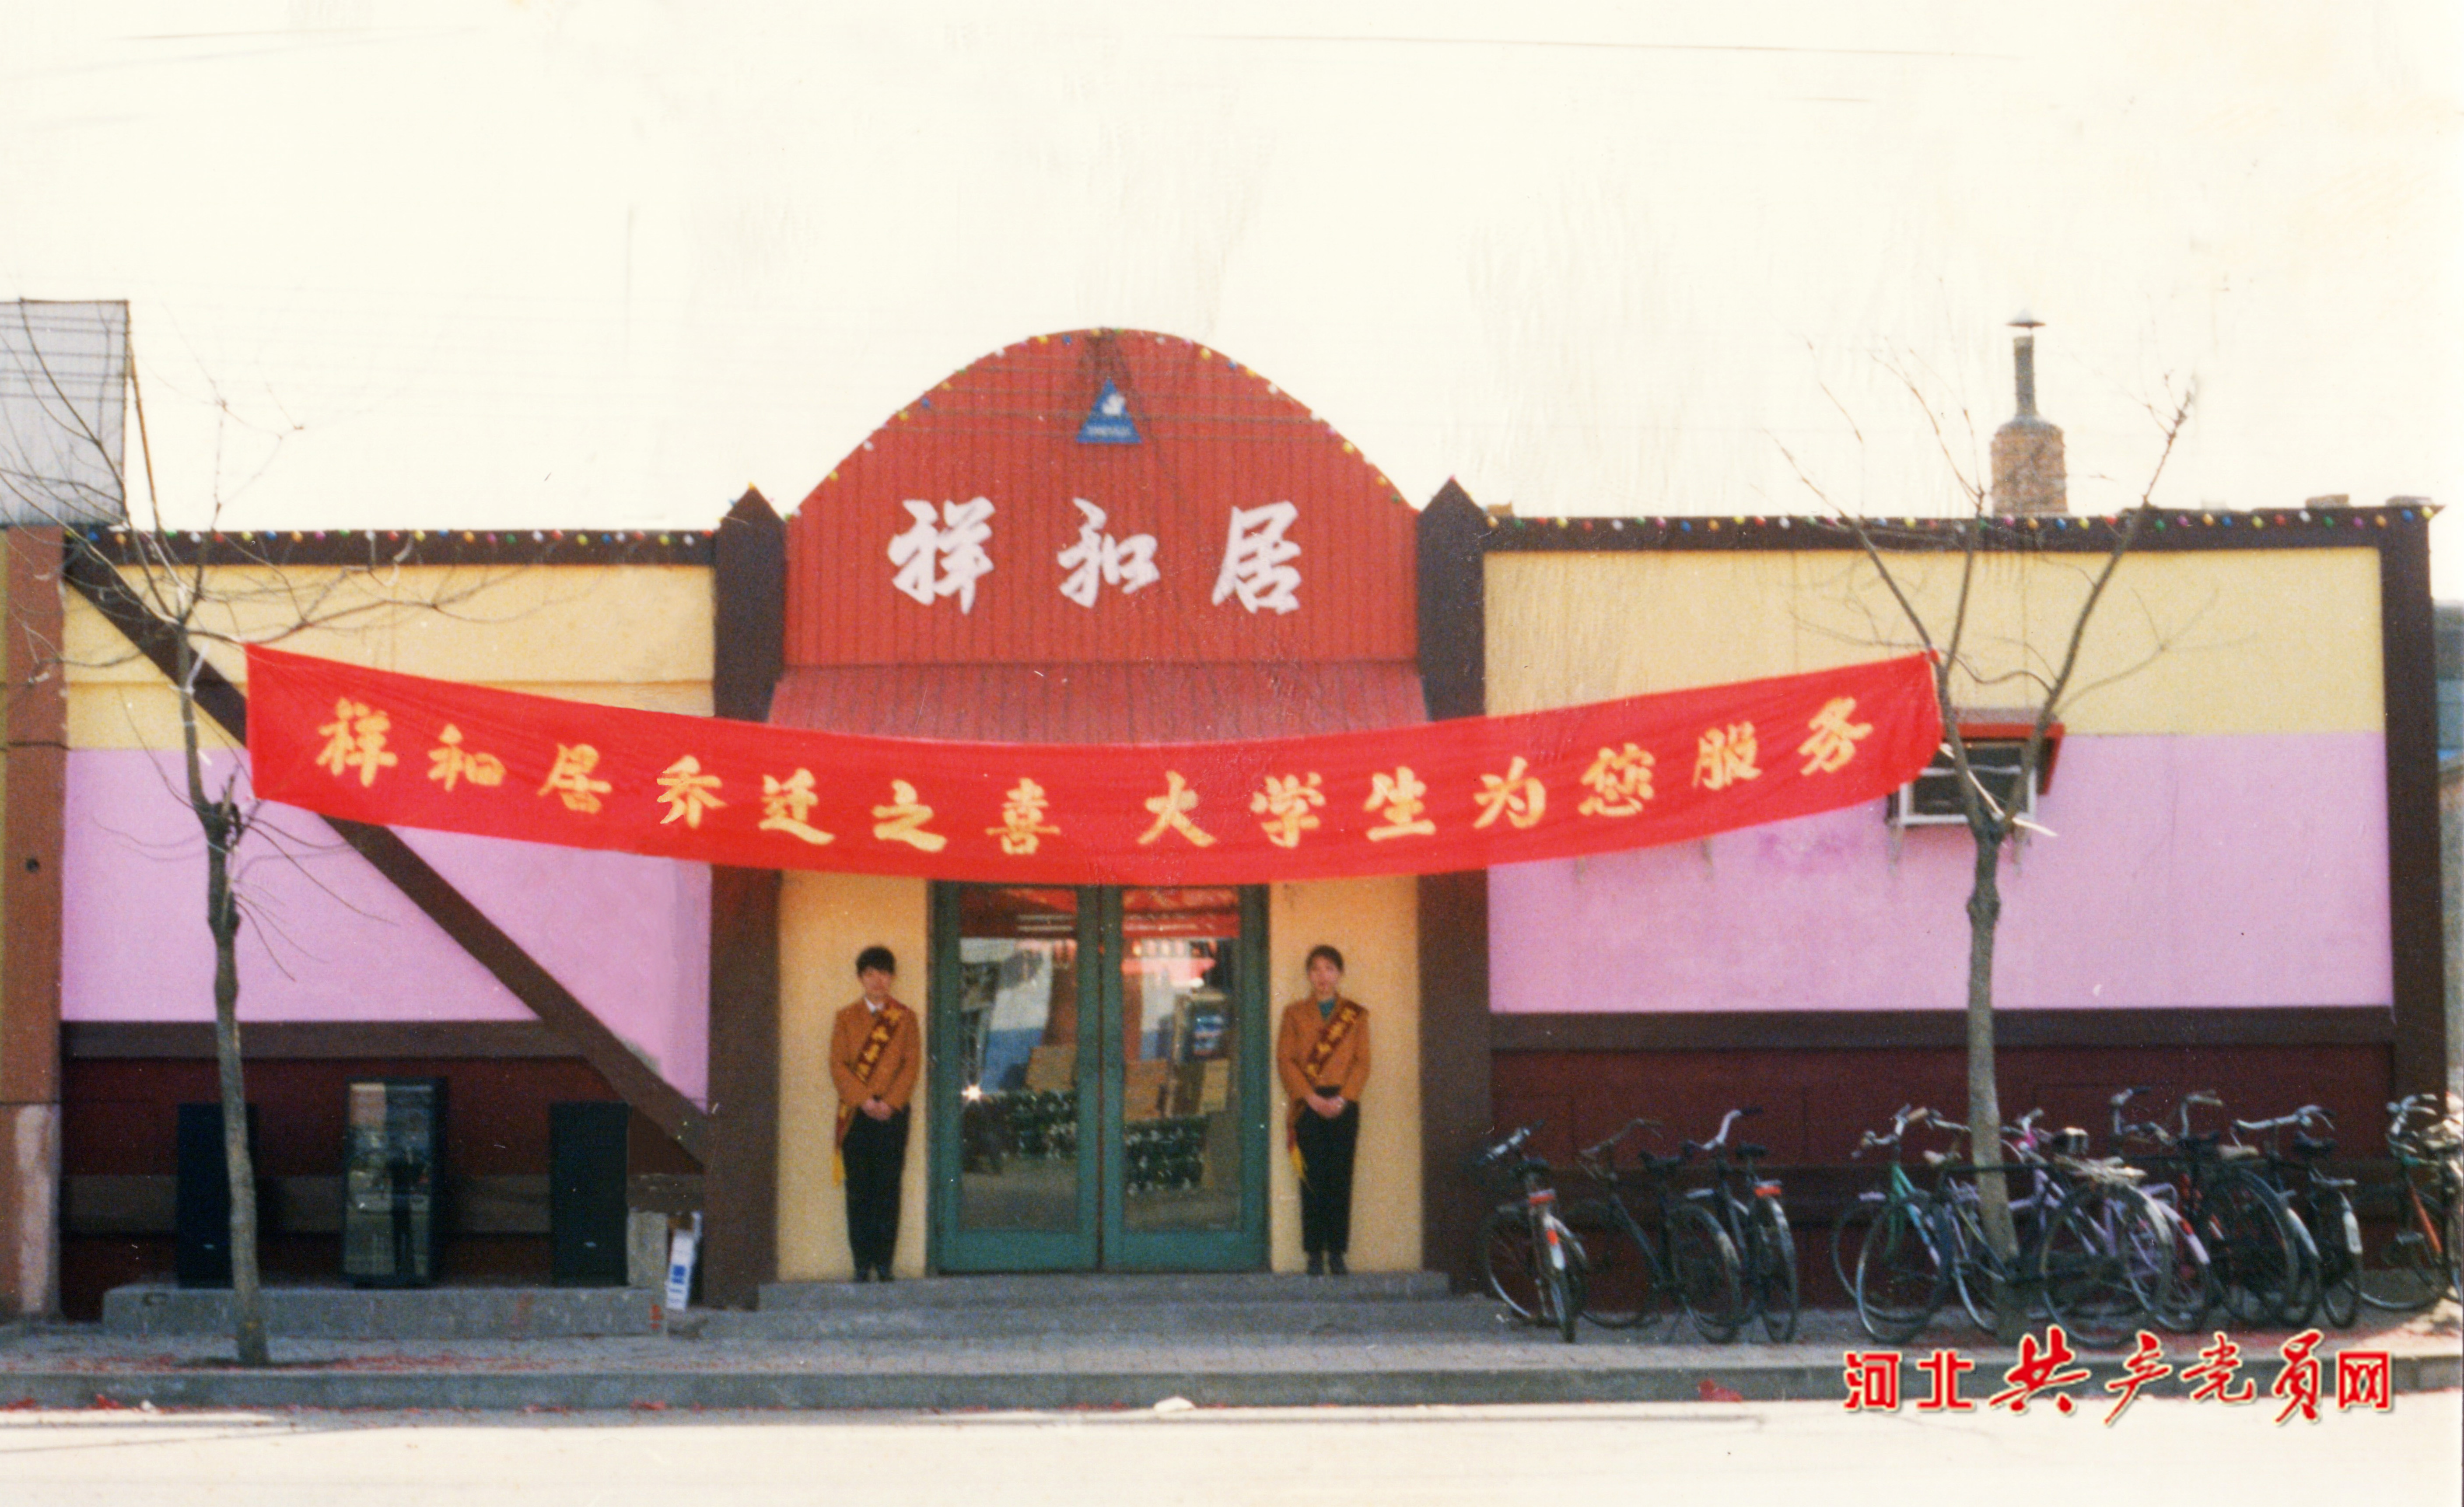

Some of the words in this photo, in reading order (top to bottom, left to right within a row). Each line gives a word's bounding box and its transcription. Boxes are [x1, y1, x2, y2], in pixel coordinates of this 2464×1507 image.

[887, 496, 1302, 614] 祥和居
[316, 697, 1060, 855] 祥和居乔迁之喜
[1138, 696, 1873, 848] 大学生为您服务
